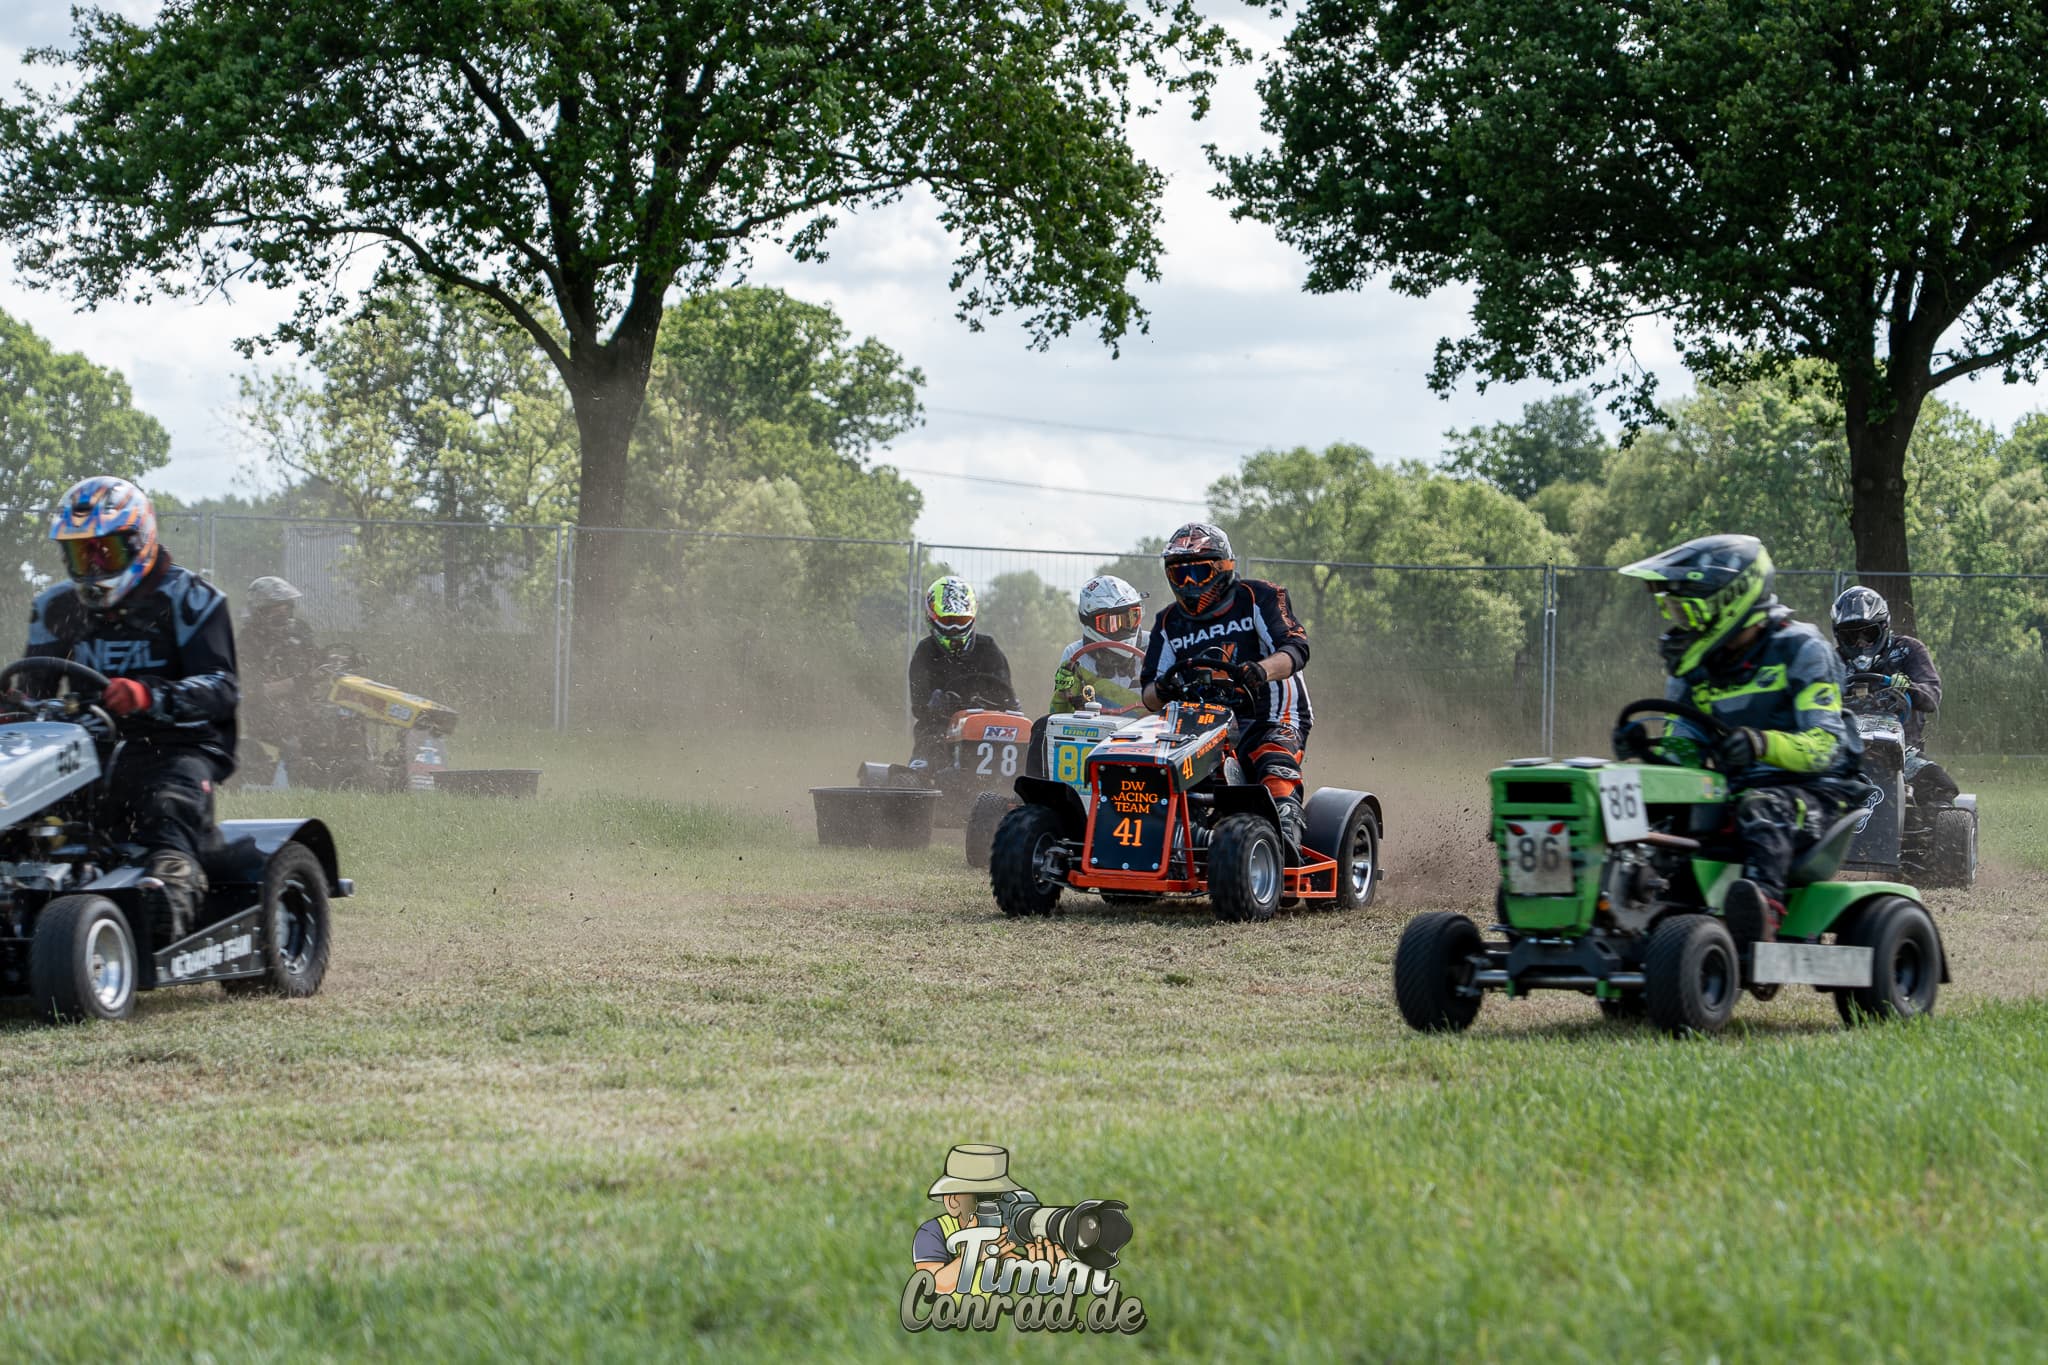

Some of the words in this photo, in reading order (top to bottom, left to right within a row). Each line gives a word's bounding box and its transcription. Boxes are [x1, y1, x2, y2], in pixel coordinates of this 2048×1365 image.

[1169, 616, 1254, 652] PHARAO
[975, 742, 1018, 777] 28
[1182, 754, 1194, 780] 41
[1121, 780, 1146, 791] DW
[1607, 783, 1637, 820] 86
[1114, 801, 1150, 814] TEAM
[1112, 817, 1143, 847] 41
[1518, 837, 1561, 873] 86
